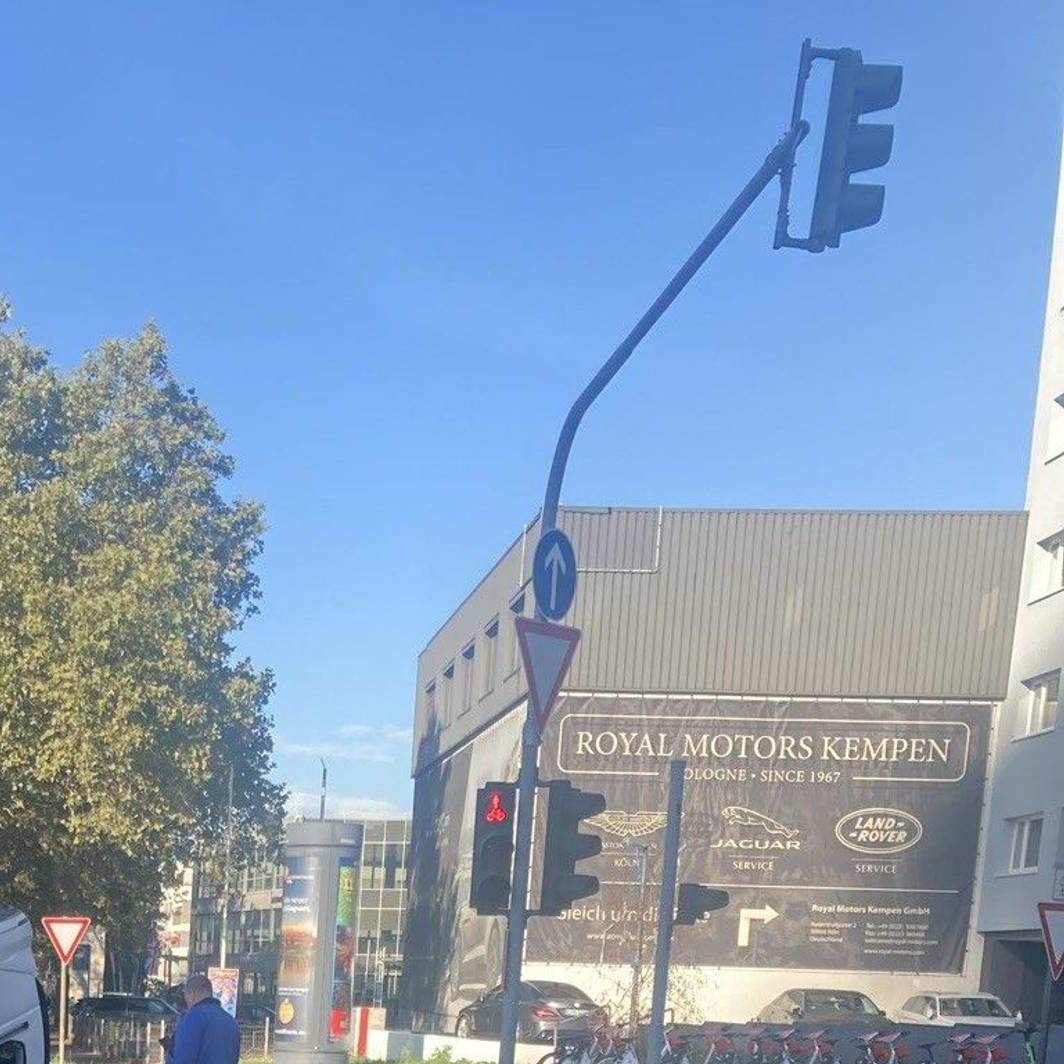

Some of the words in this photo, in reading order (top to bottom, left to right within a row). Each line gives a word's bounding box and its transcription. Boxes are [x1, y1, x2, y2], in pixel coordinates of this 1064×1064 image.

[576, 731, 674, 757] ROYAL
[681, 733, 813, 760] MOTORS
[820, 736, 951, 762] KEMPEN
[683, 767, 747, 782] OLOGNE
[760, 769, 805, 783] SINCE
[810, 771, 841, 783] 1967
[710, 839, 801, 850] JAGUAR
[732, 860, 775, 871] SERVICE
[855, 864, 897, 874] SERVICE
[811, 904, 836, 914] Royal
[837, 905, 866, 914] Motors
[867, 906, 902, 915] Kempen
[903, 906, 931, 914] GmbH
